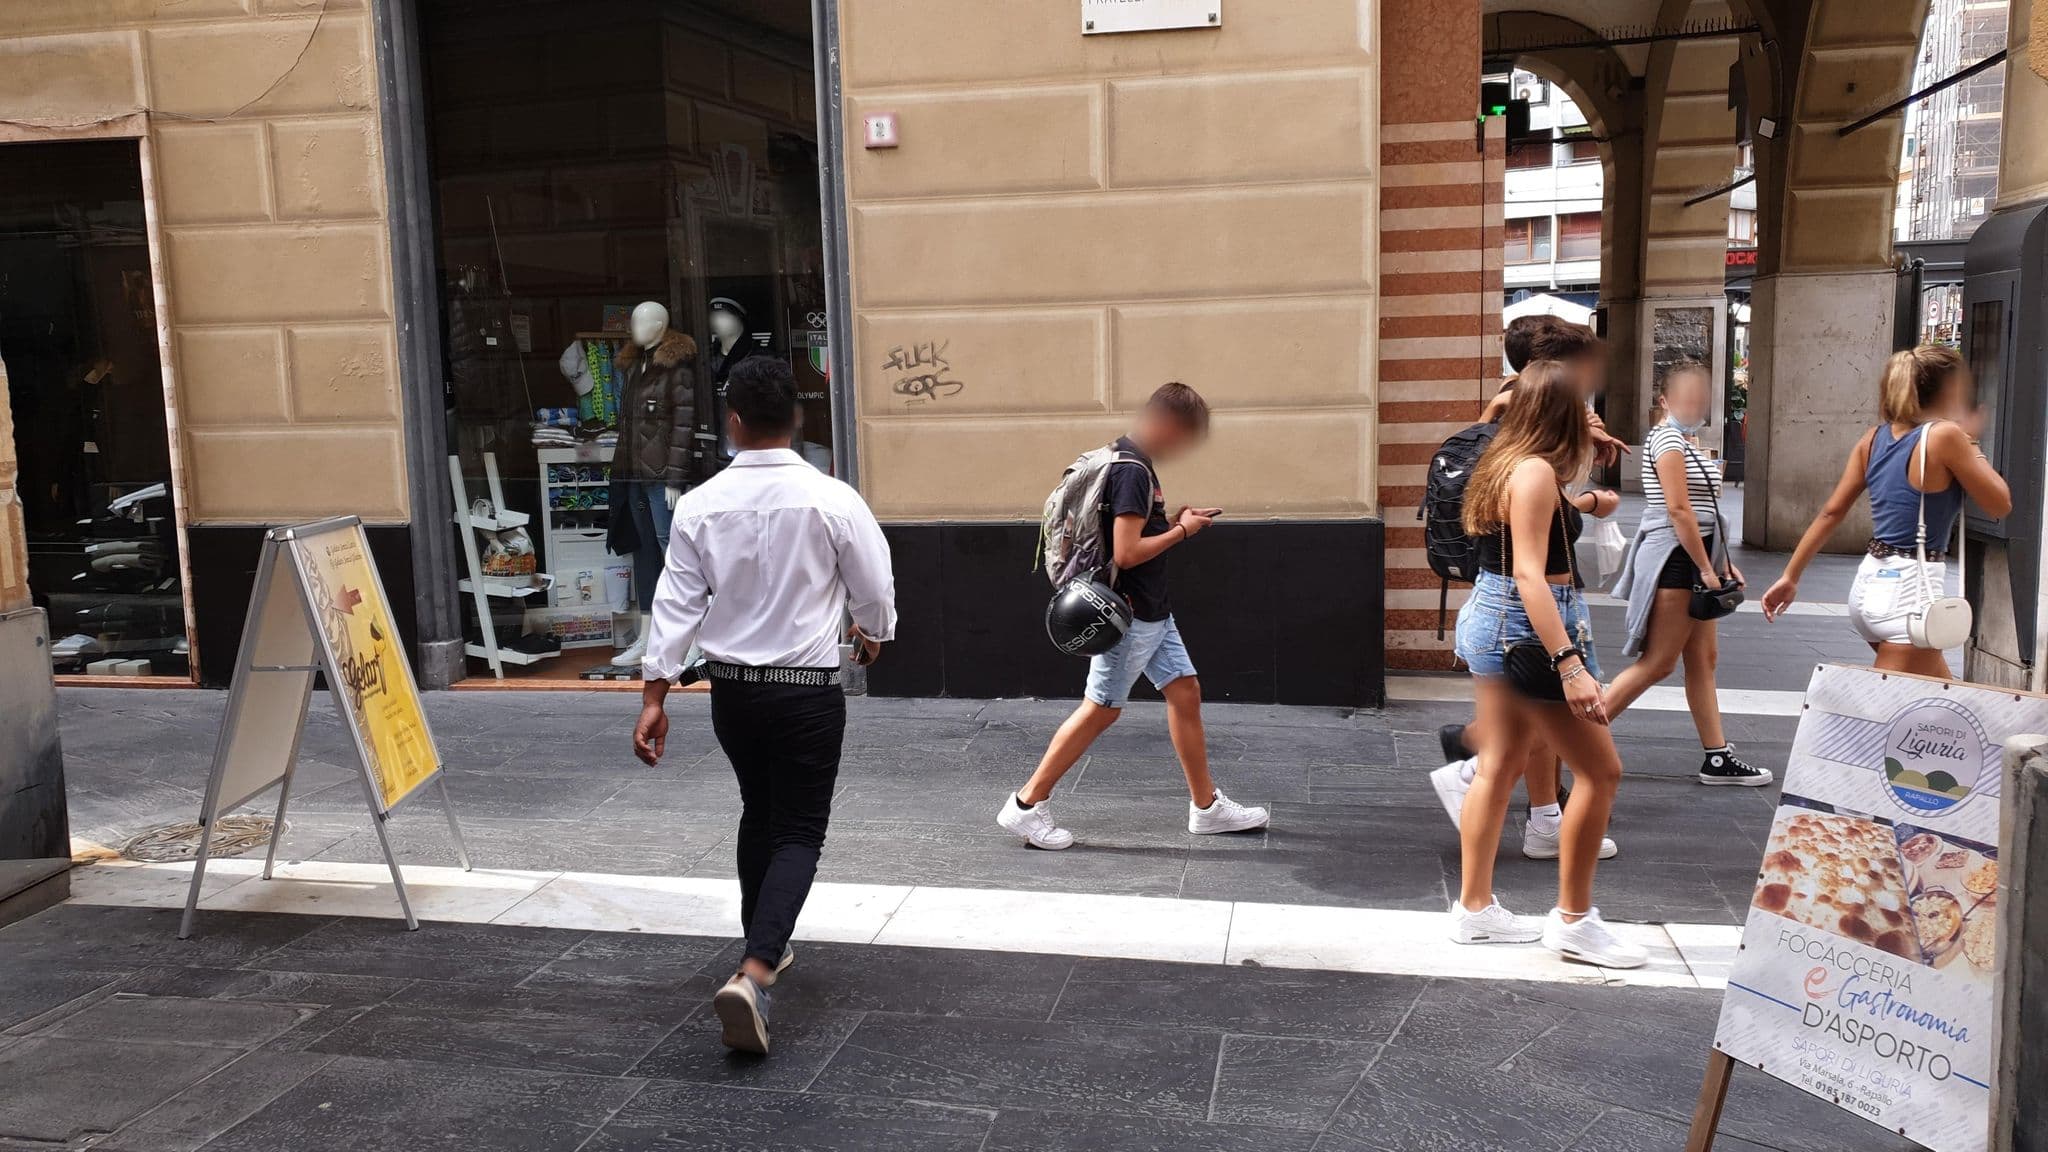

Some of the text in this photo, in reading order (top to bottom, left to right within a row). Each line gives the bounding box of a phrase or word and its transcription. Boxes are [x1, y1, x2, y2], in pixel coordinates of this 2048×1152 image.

[797, 391, 825, 399] OLYMPIC
[1896, 727, 1969, 761] Liguria
[1917, 722, 1968, 740] SAPORI DI
[1904, 791, 1939, 806] RAPALLO
[1777, 929, 1913, 994] FOCACCERIA
[1803, 966, 1970, 1044] e Gastronomia
[1802, 1001, 1952, 1082] D'ASPORTO
[1791, 1036, 1839, 1066] SAPORI
[1858, 1063, 1913, 1099] LIGURIA
[1799, 1057, 1813, 1072] Via
[1812, 1061, 1846, 1087] Marsala,
[1846, 1079, 1855, 1089] 6
[1860, 1085, 1894, 1107] Rapallo
[1815, 1081, 1839, 1099] 0185
[1840, 1091, 1857, 1107] 187
[1857, 1098, 1882, 1117] 0023
